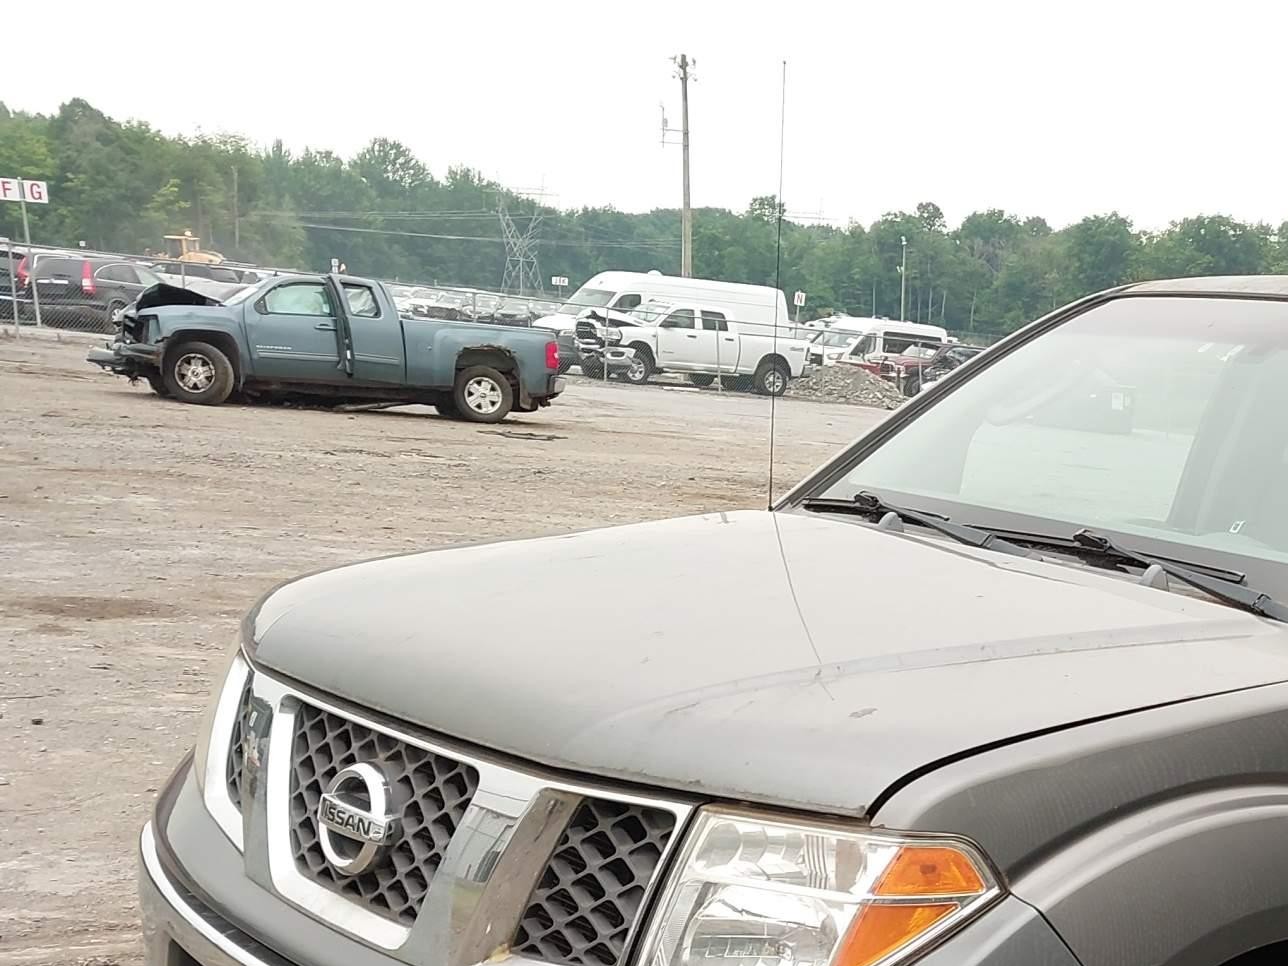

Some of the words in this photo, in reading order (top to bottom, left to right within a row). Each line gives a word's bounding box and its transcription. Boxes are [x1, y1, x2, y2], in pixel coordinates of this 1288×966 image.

[1, 181, 12, 198] F
[30, 182, 43, 201] G
[321, 800, 372, 836] ISSAN
